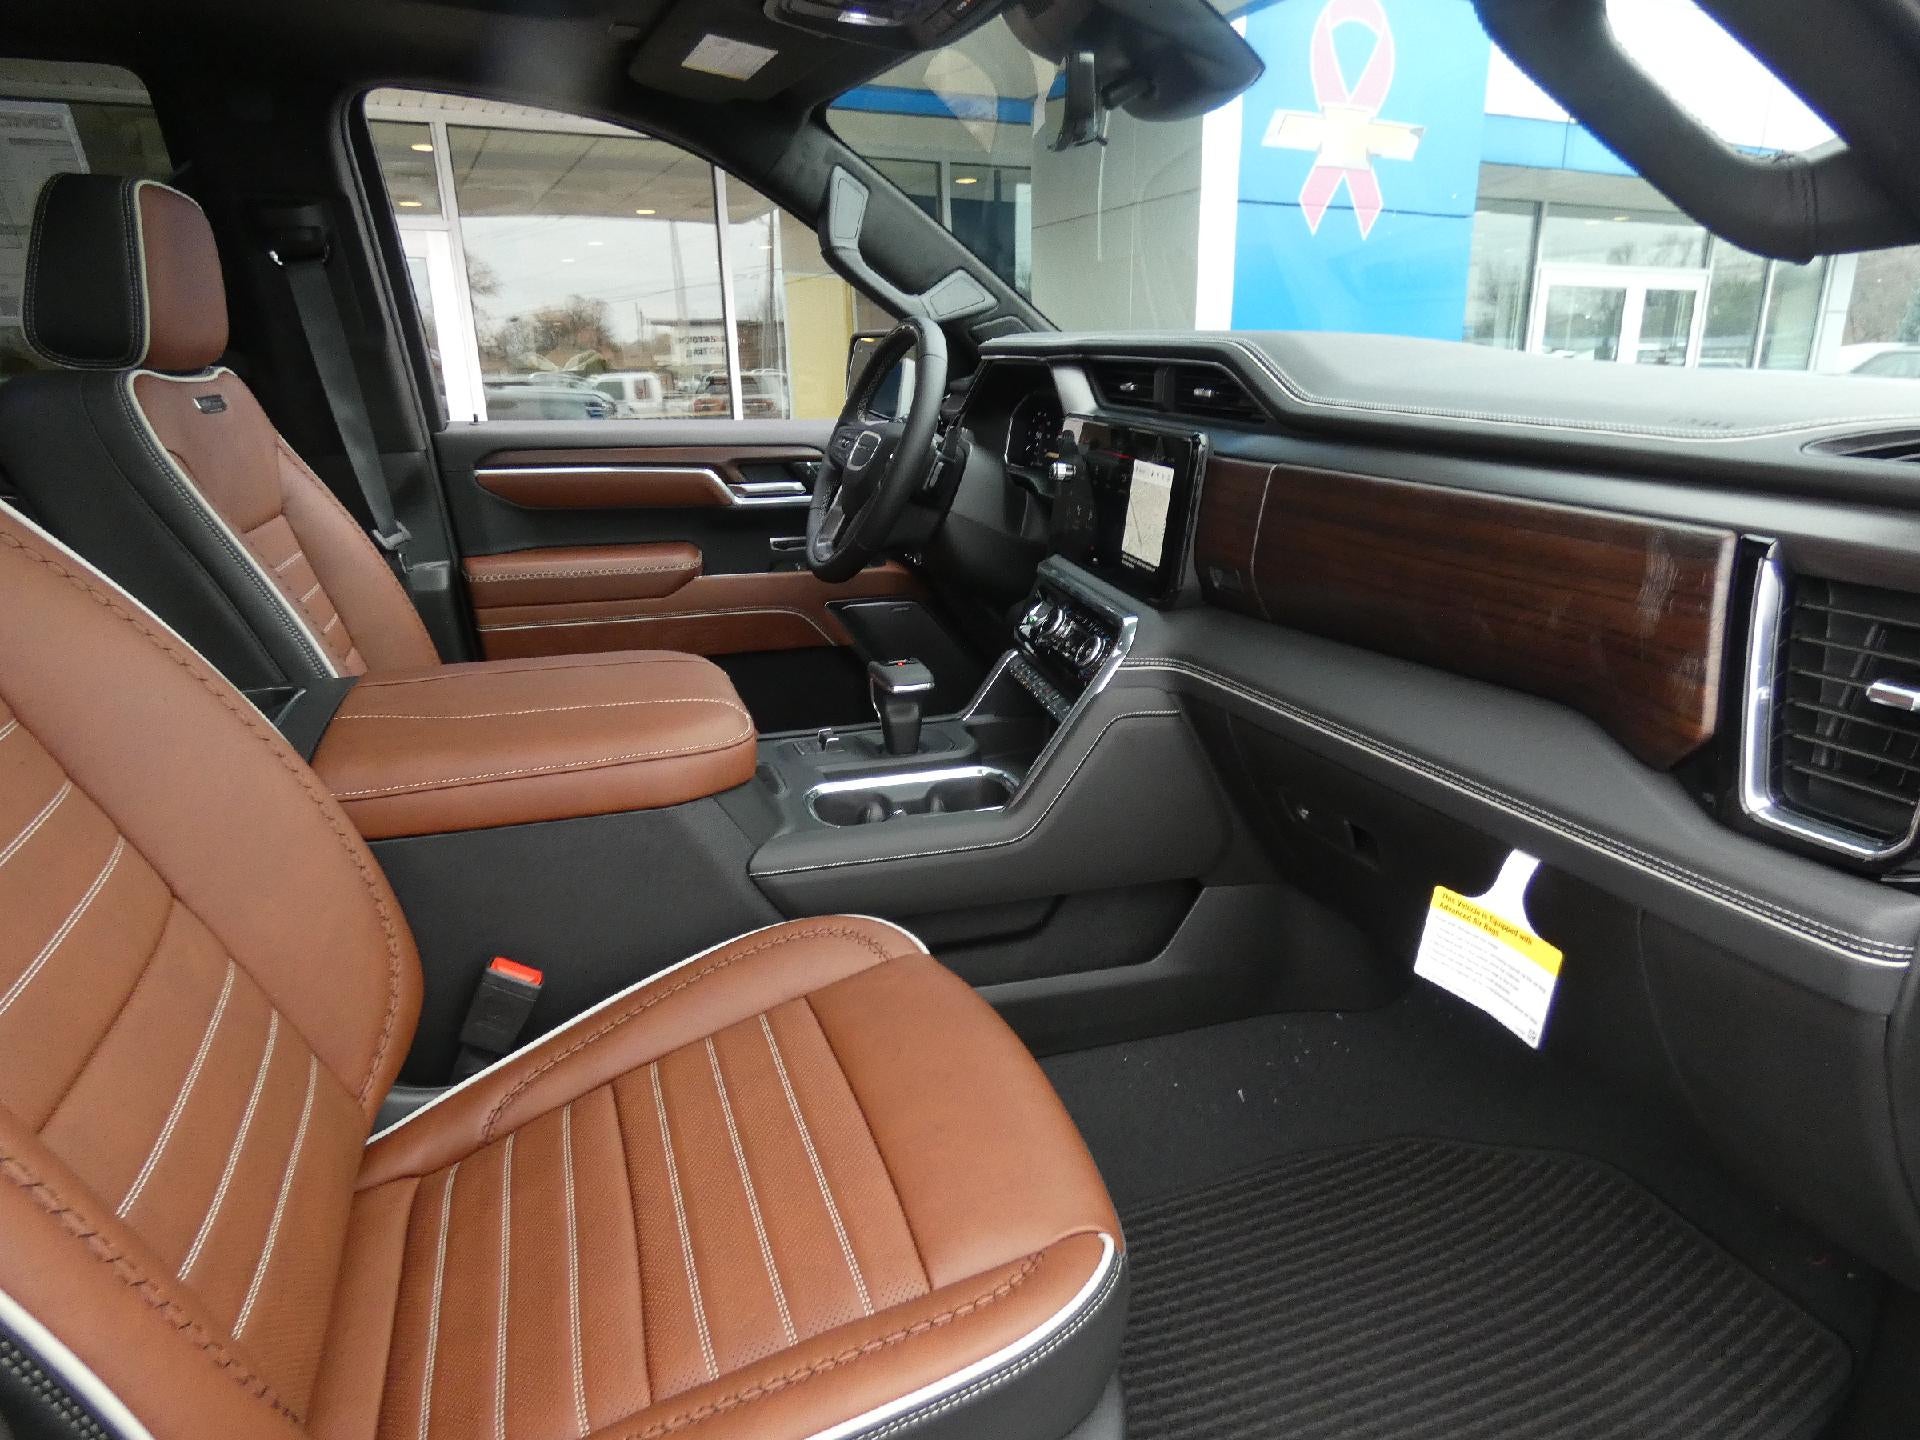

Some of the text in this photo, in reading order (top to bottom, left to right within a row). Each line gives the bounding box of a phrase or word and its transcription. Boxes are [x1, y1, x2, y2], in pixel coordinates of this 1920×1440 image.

[1440, 902, 1472, 922] Advanced
[1490, 915, 1519, 937] Equipped
[1520, 933, 1532, 945] with
